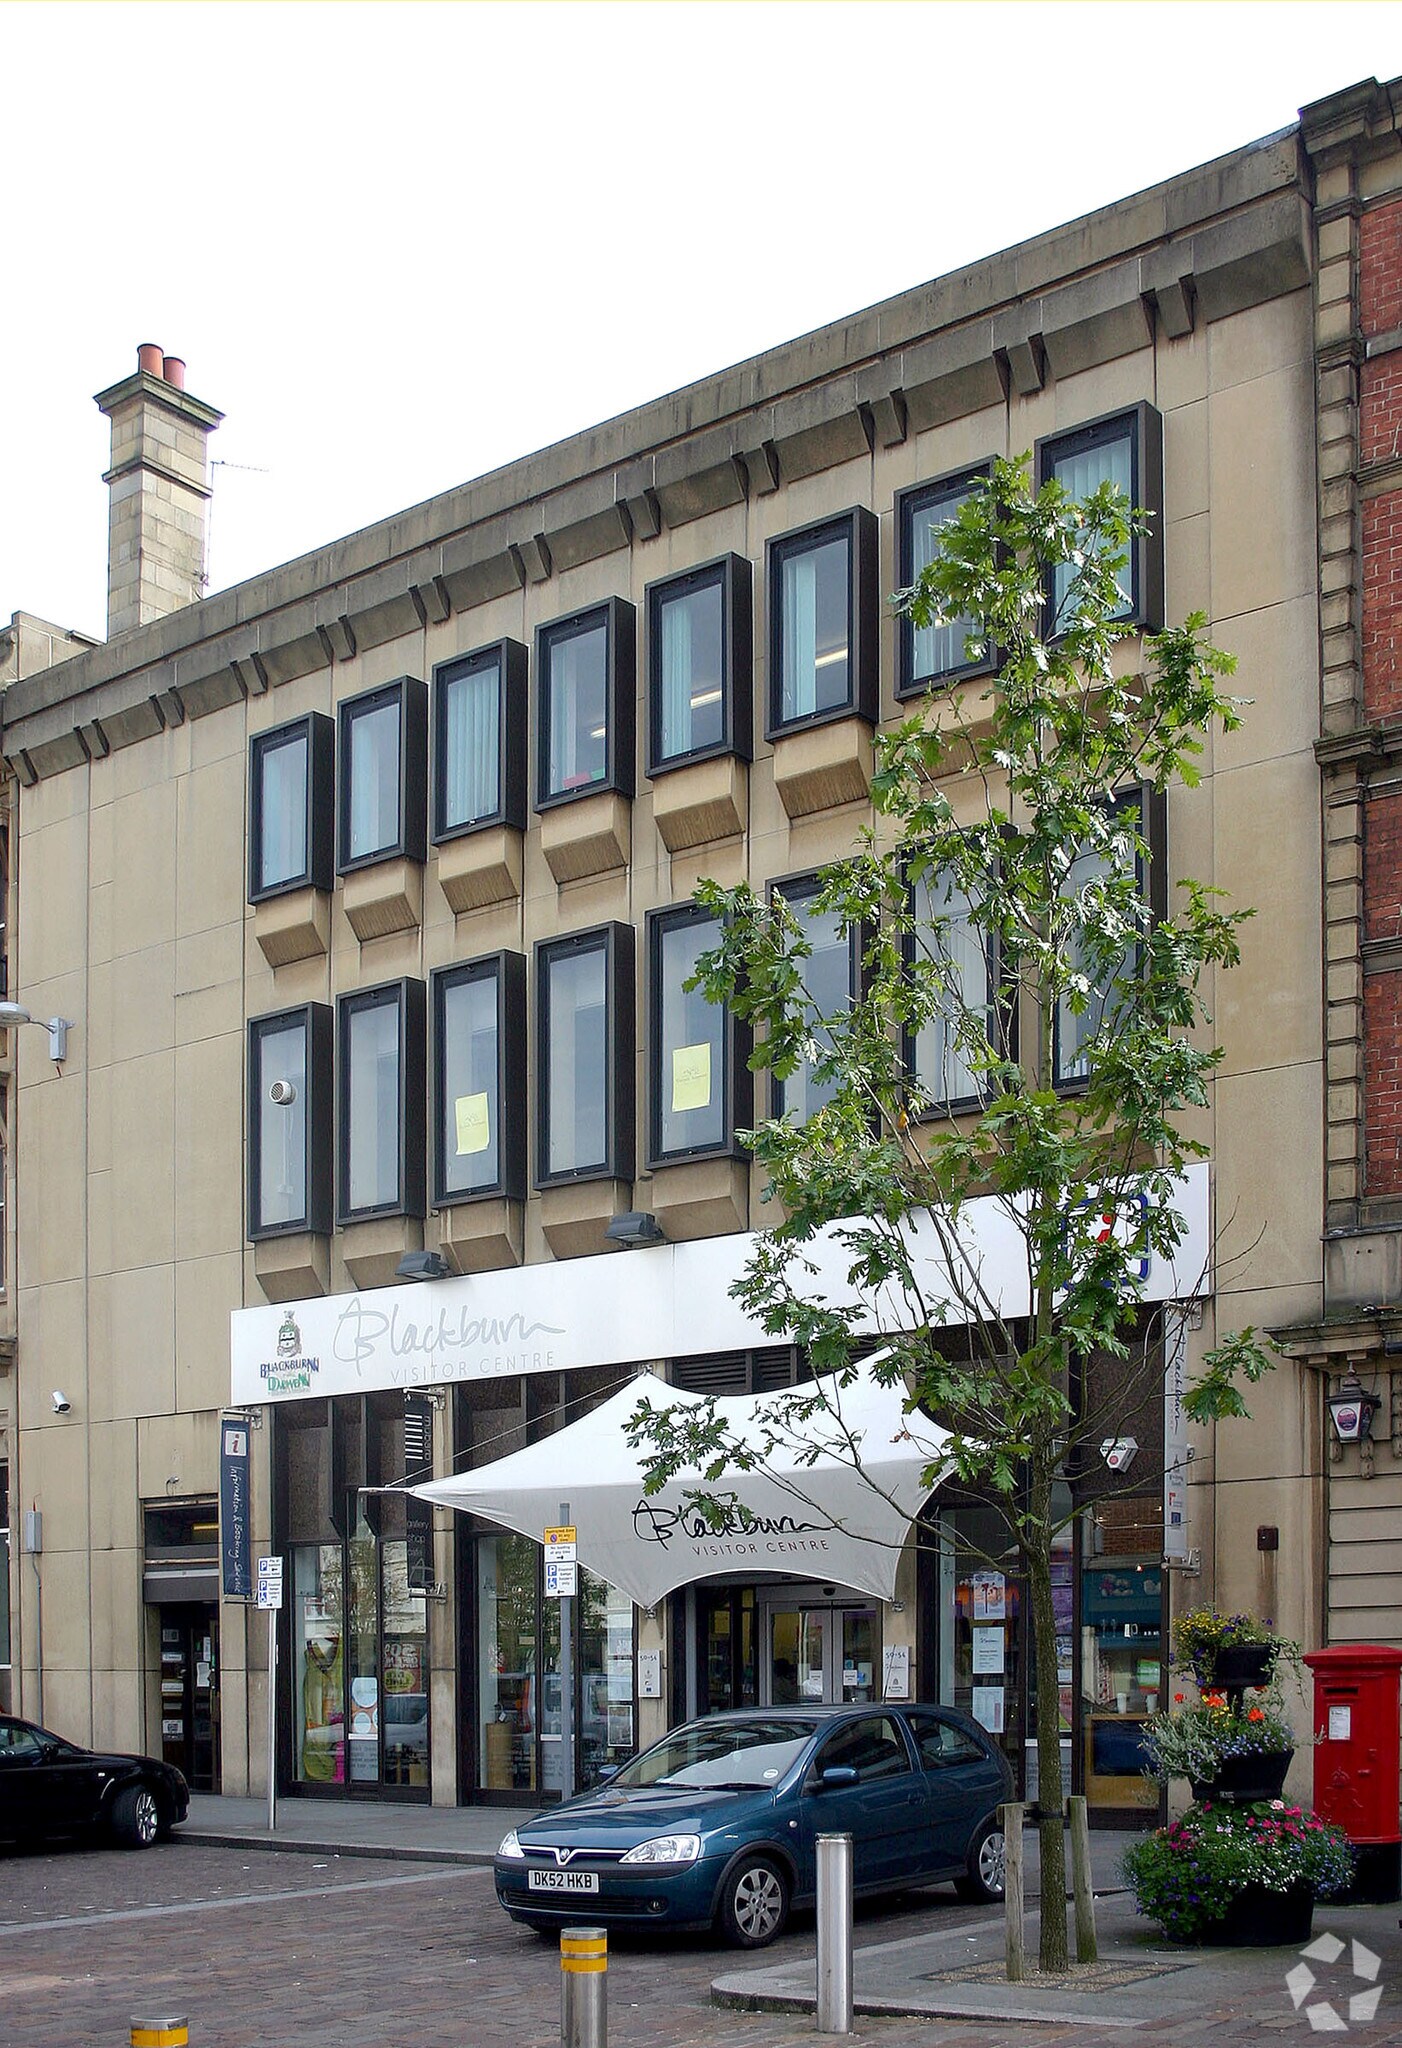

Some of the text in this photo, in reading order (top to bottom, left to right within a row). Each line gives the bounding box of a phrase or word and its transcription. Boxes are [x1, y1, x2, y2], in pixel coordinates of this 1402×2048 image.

[332, 1296, 567, 1377] Blackburn
[391, 1351, 555, 1384] VISITOR CENTRE
[692, 1539, 830, 1557] VISITOR CENTRE
[534, 1871, 592, 1888] DK52 HKB
